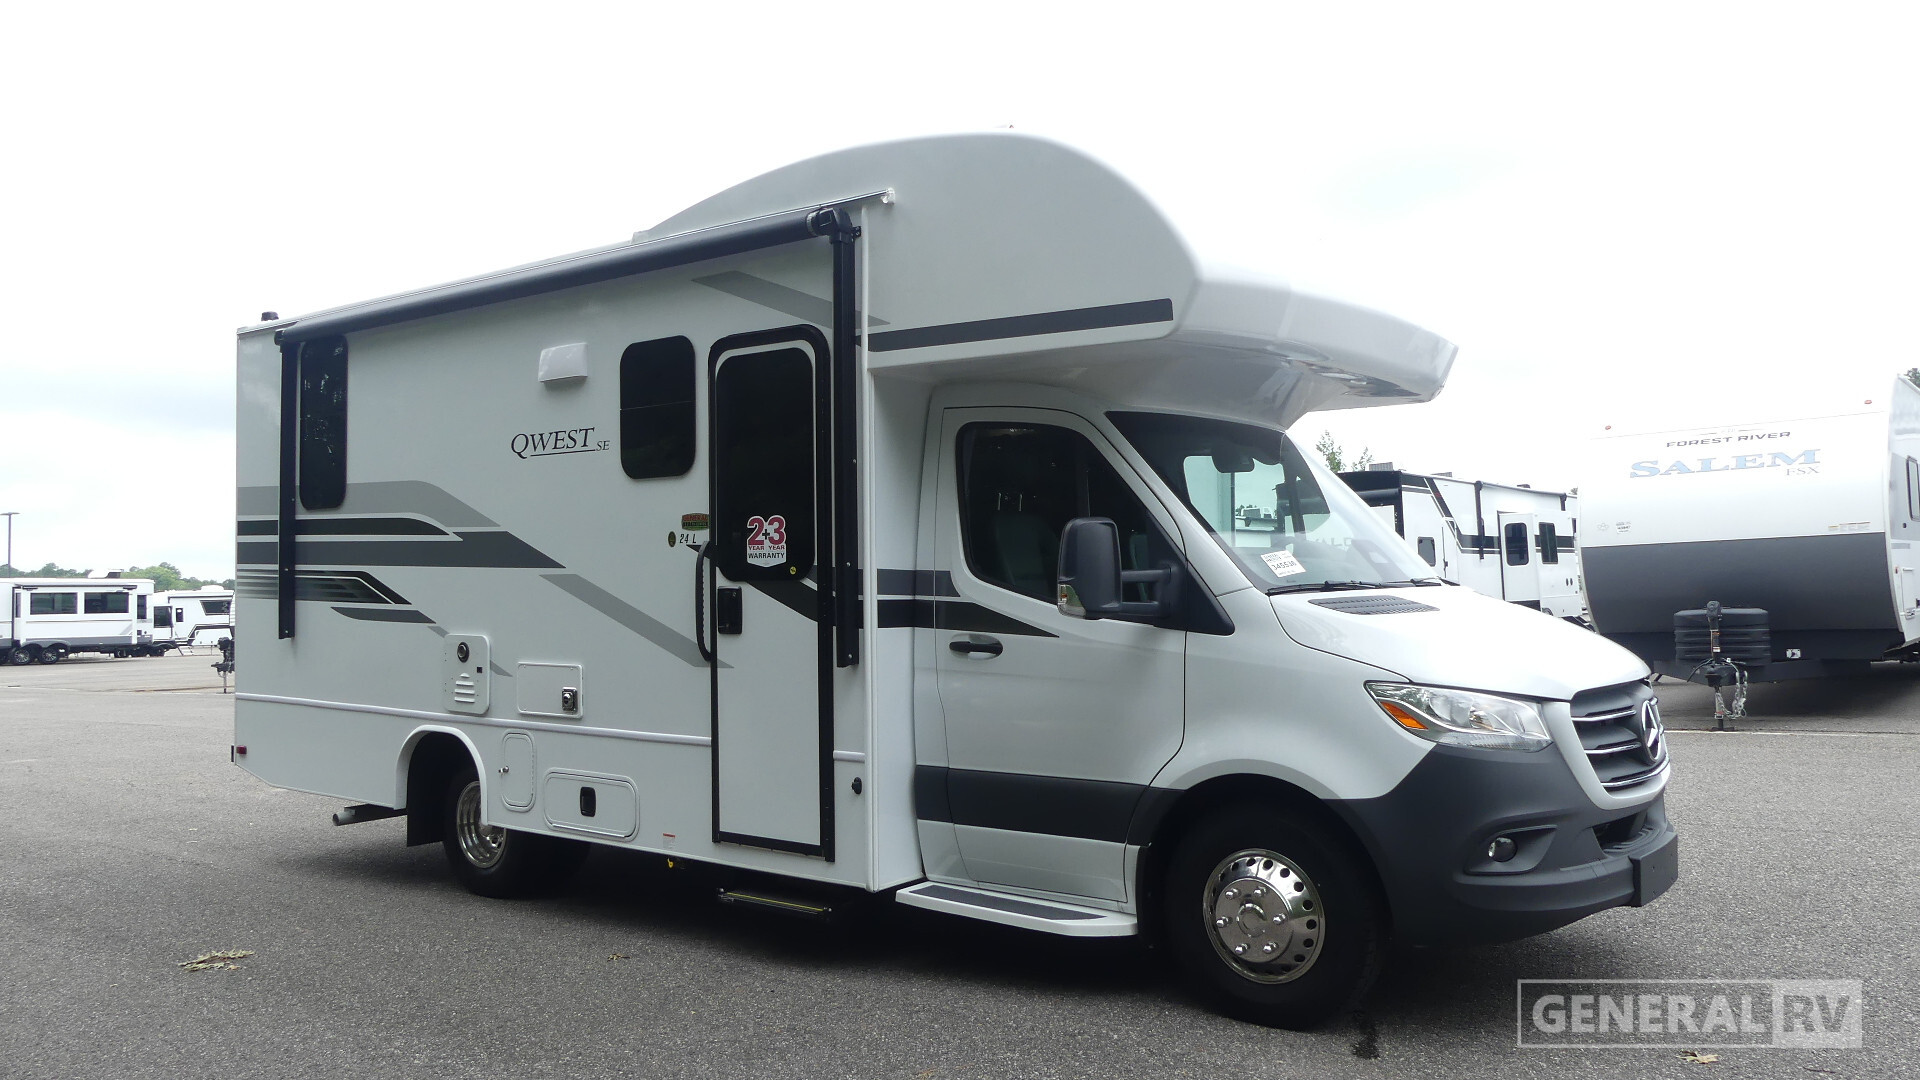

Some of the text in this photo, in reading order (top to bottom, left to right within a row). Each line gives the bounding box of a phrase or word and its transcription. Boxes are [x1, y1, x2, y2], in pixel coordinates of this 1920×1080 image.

[511, 427, 610, 459] QWEST SE
[1666, 431, 1791, 448] FOREST RIVER
[1629, 448, 1821, 478] SALEM
[1785, 466, 1821, 476] FSX
[679, 533, 697, 544] 24 L
